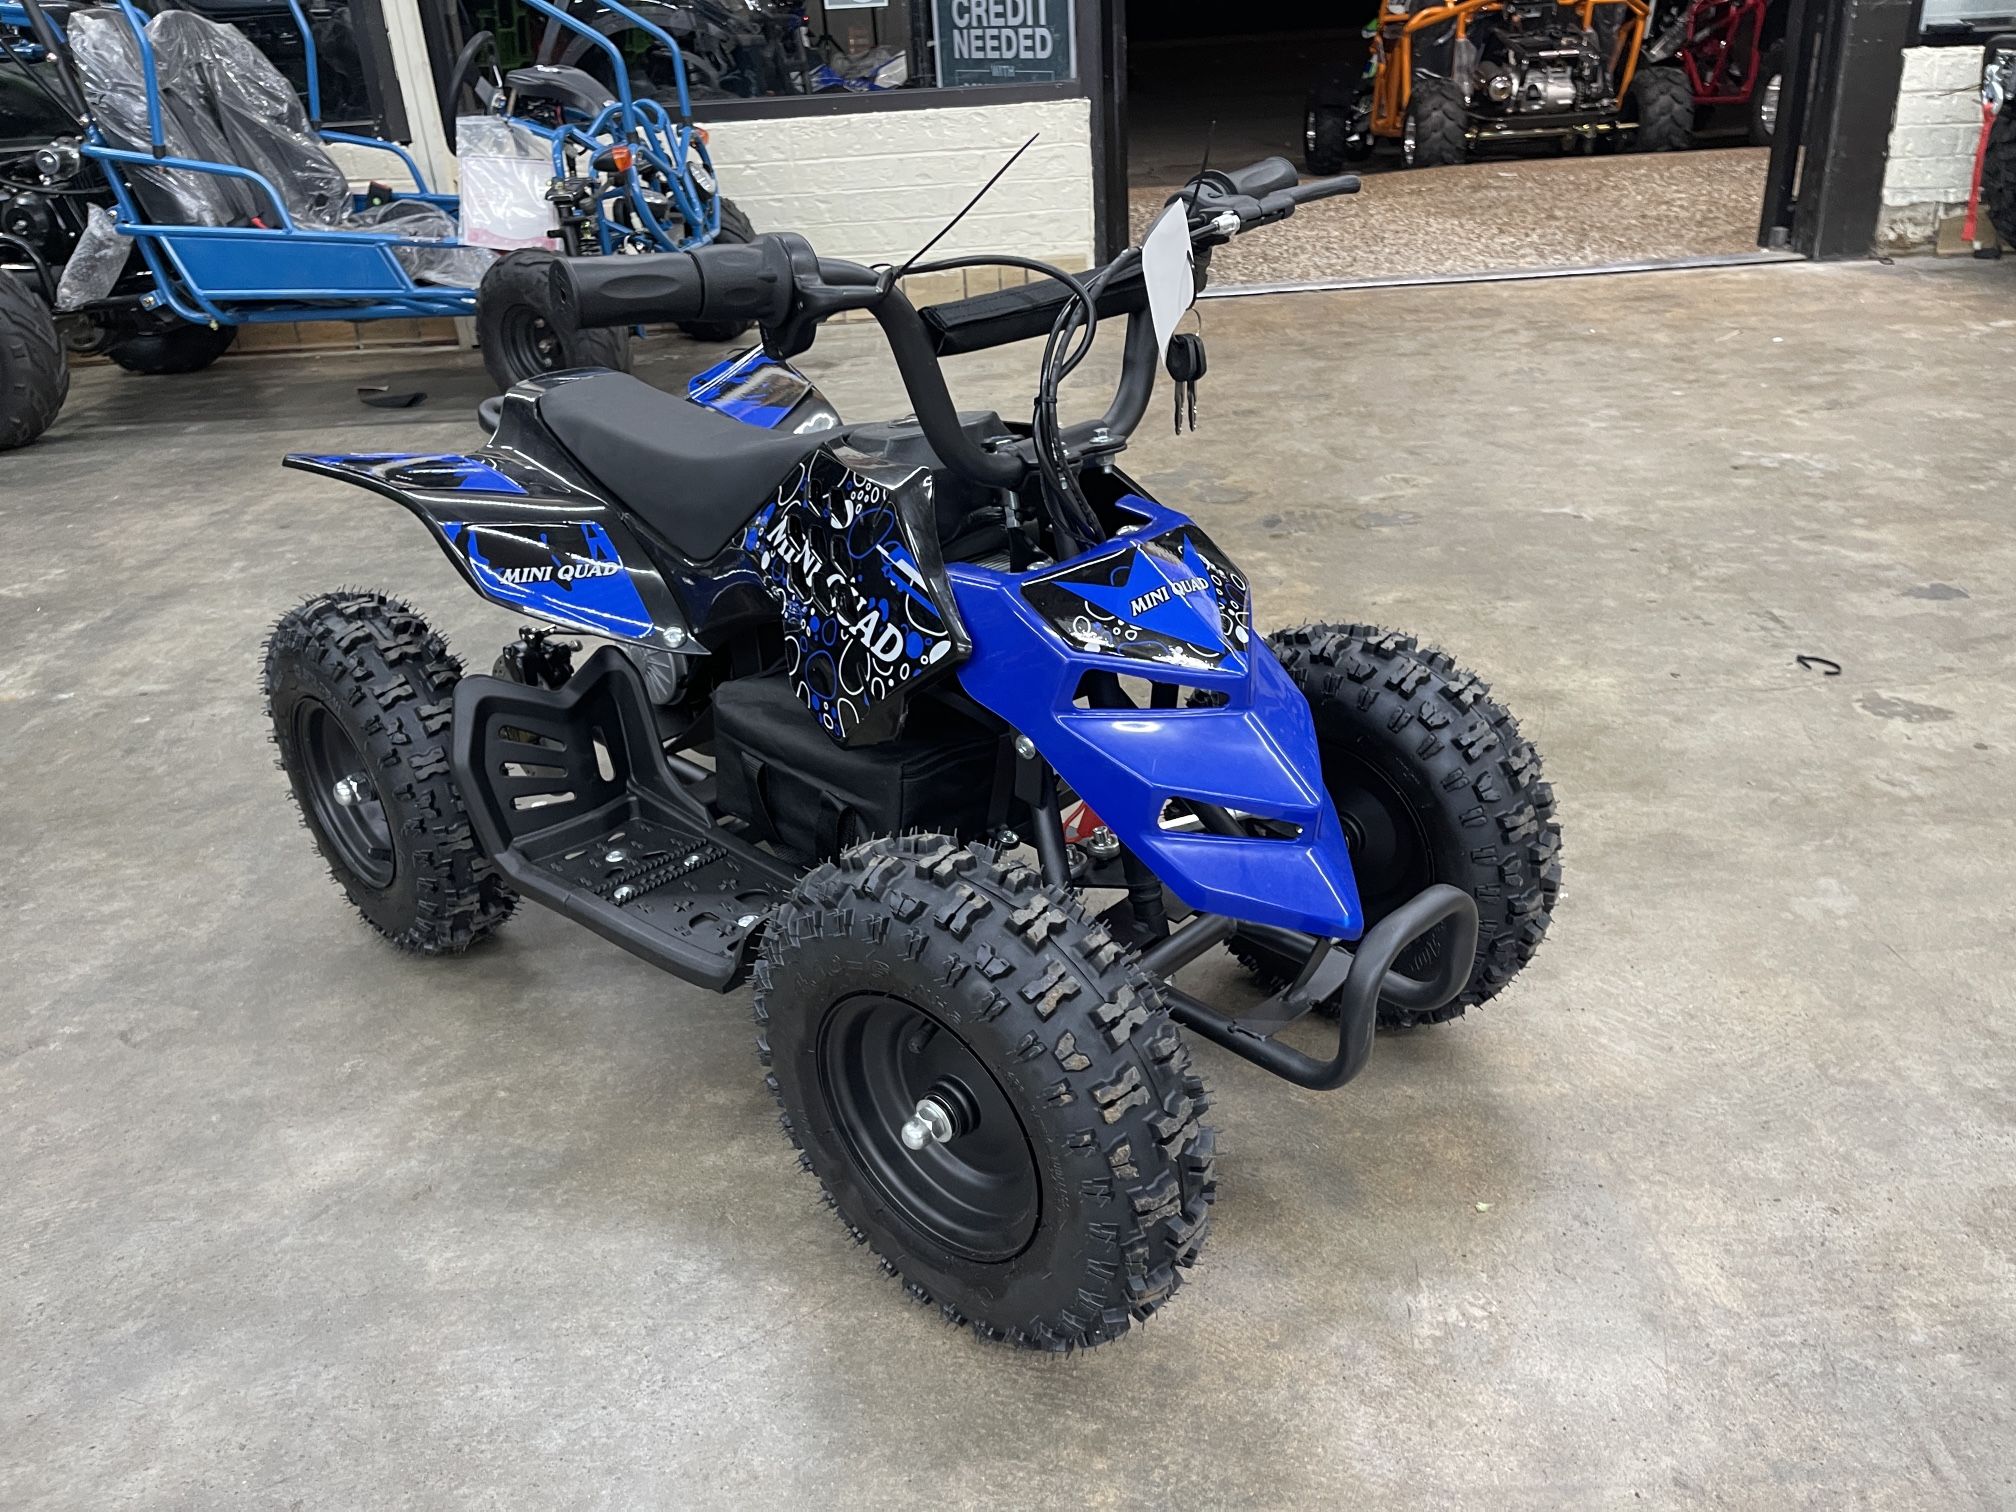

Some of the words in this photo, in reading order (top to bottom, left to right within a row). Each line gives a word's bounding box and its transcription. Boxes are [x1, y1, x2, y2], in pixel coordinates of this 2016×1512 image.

[951, 0, 1047, 28] CREDIT
[952, 28, 1053, 59] NEEDED
[500, 566, 553, 584] MINI
[557, 562, 620, 581] QUAD
[1130, 587, 1171, 617] MINI
[1171, 577, 1210, 597] QUAD
